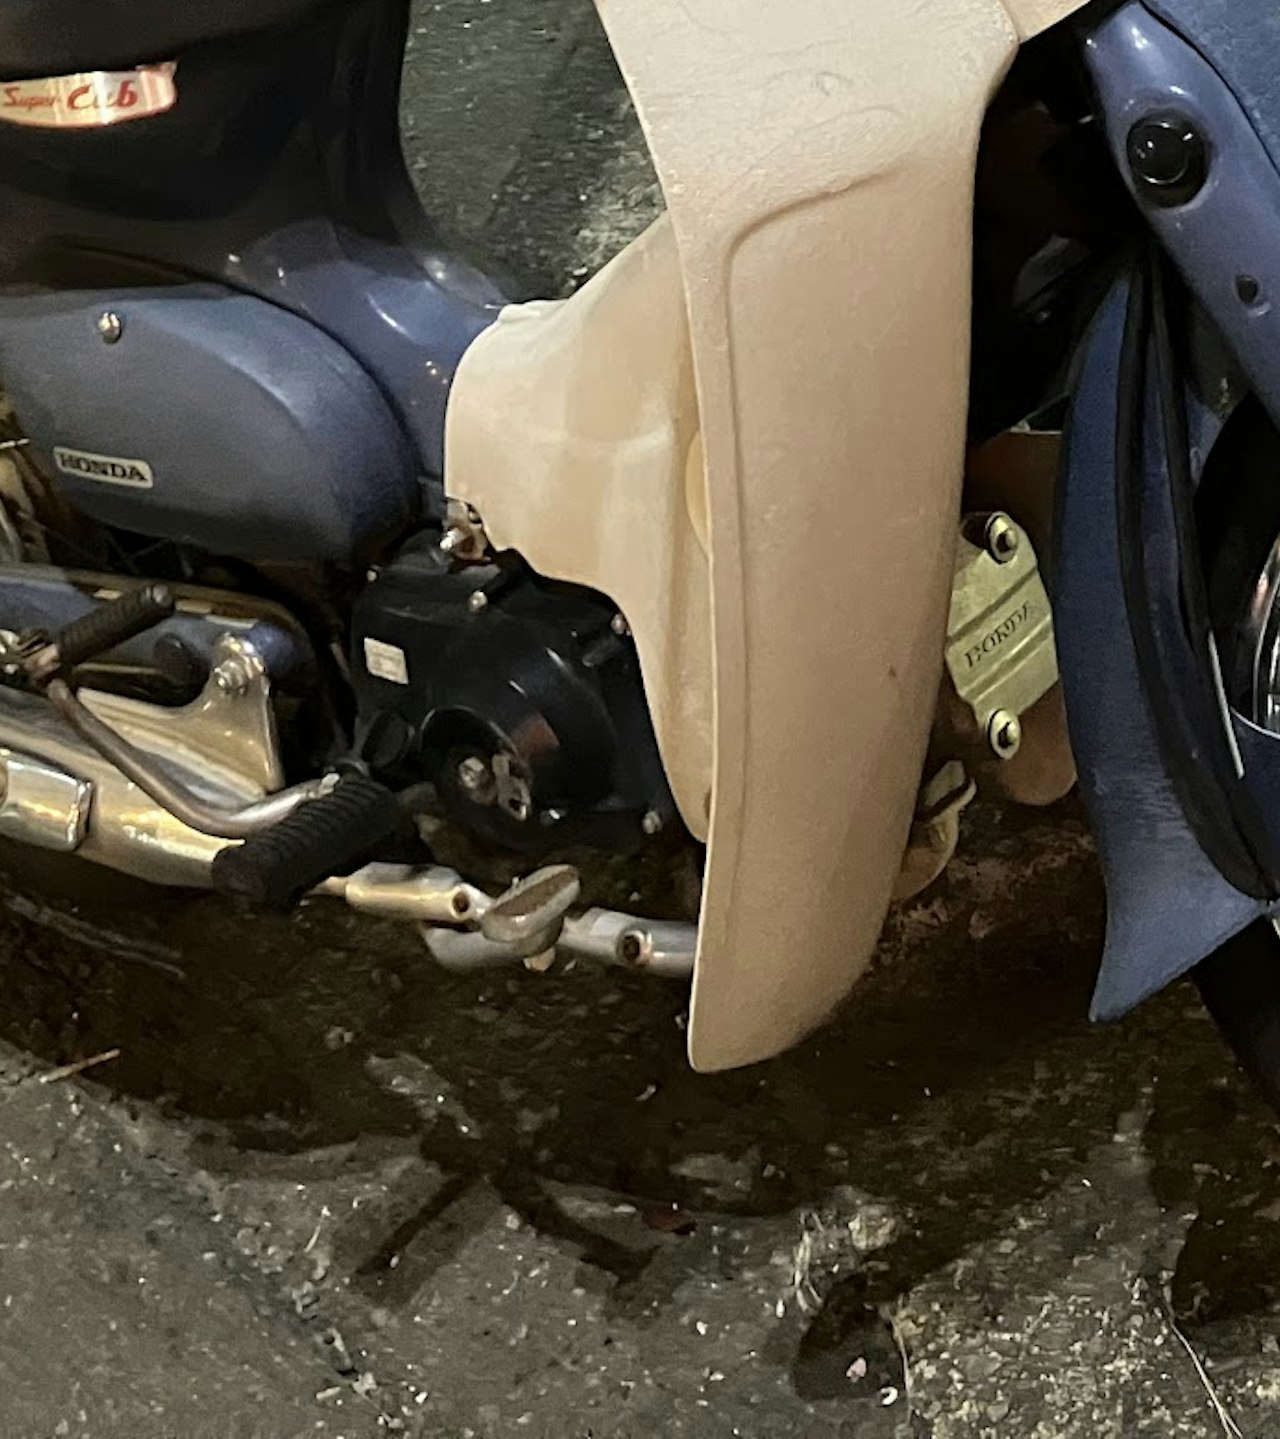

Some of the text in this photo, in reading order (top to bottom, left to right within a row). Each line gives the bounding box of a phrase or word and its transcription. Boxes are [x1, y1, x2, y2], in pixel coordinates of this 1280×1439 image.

[4, 80, 137, 110] Super Cub
[59, 452, 149, 481] HONDA
